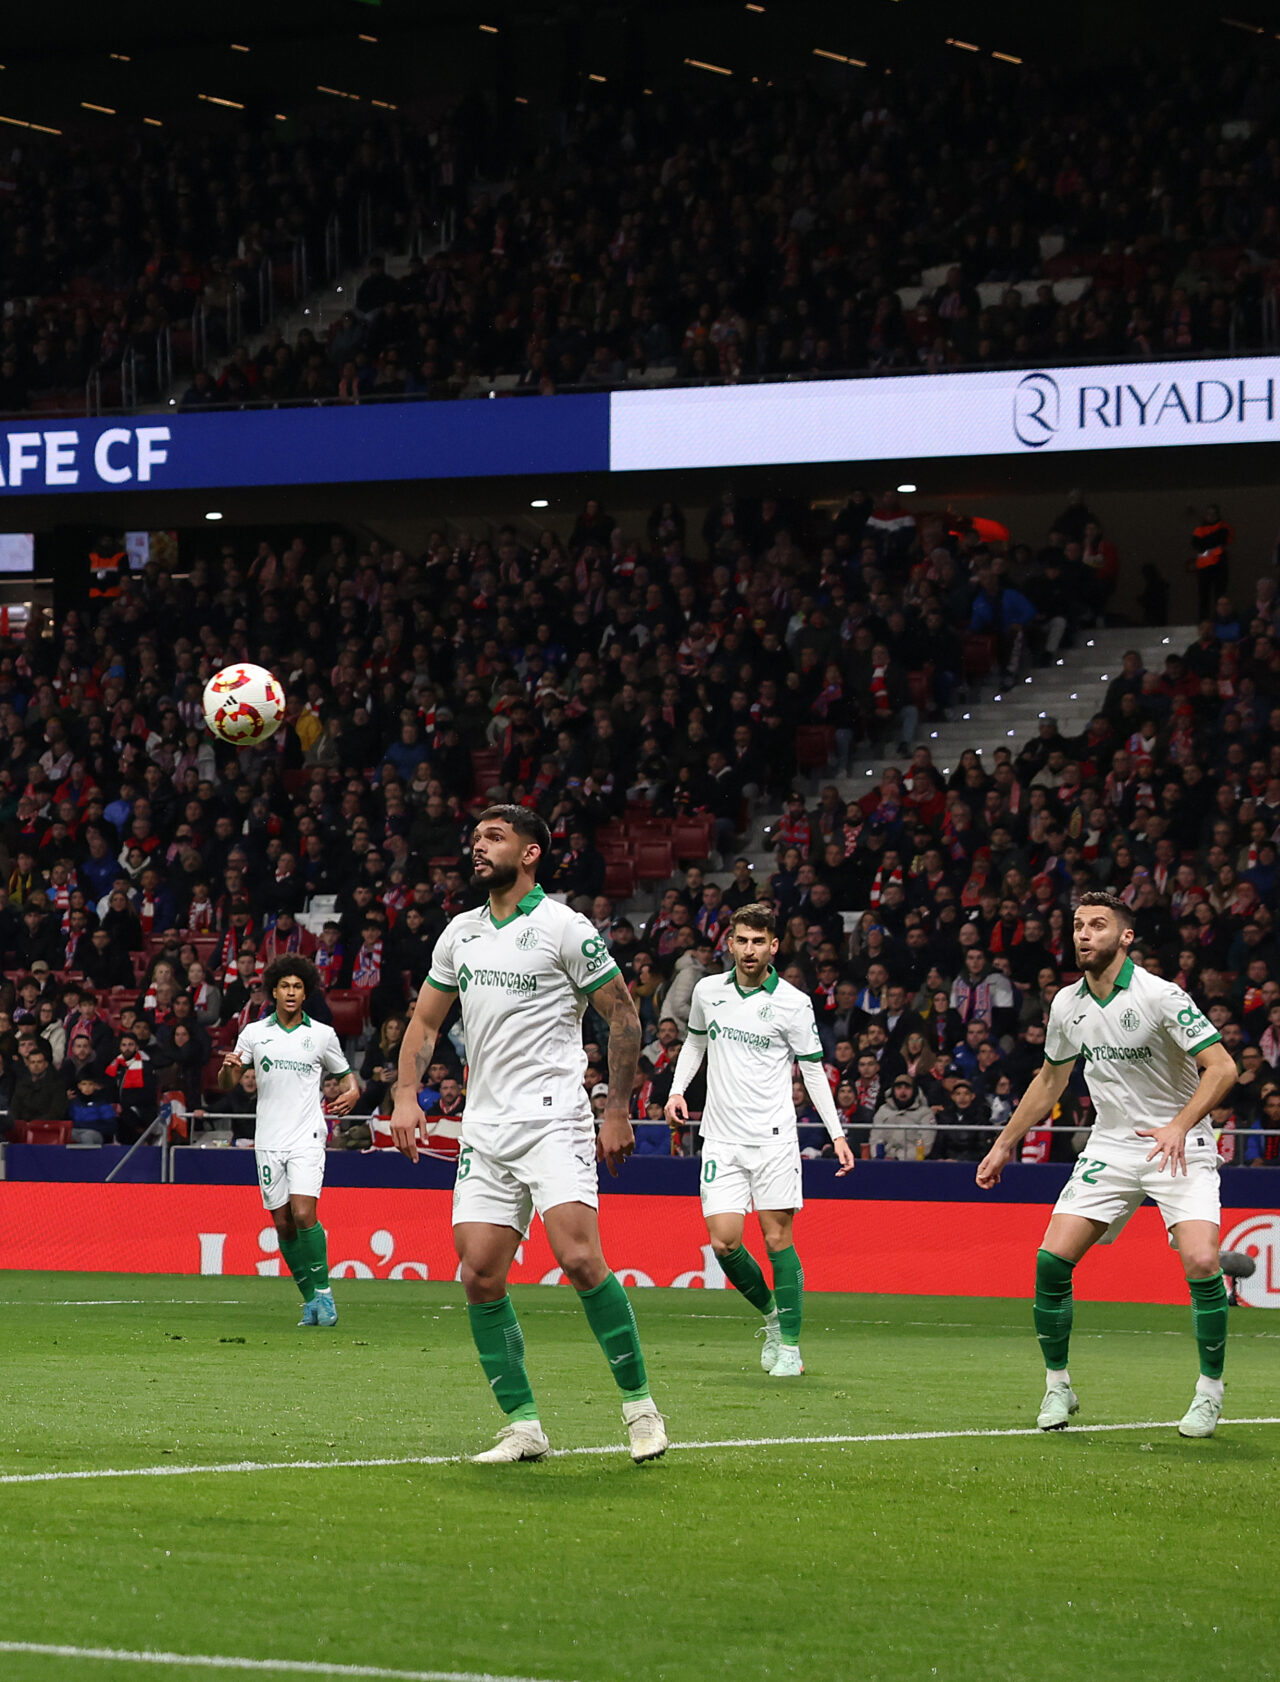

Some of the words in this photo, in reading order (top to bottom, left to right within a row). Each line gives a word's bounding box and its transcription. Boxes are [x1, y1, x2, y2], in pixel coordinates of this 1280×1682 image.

[1079, 379, 1274, 429] RIYADH
[94, 427, 171, 482] CF
[474, 969, 537, 991] TECNOCASA
[1093, 1046, 1152, 1061] TECNOCASA
